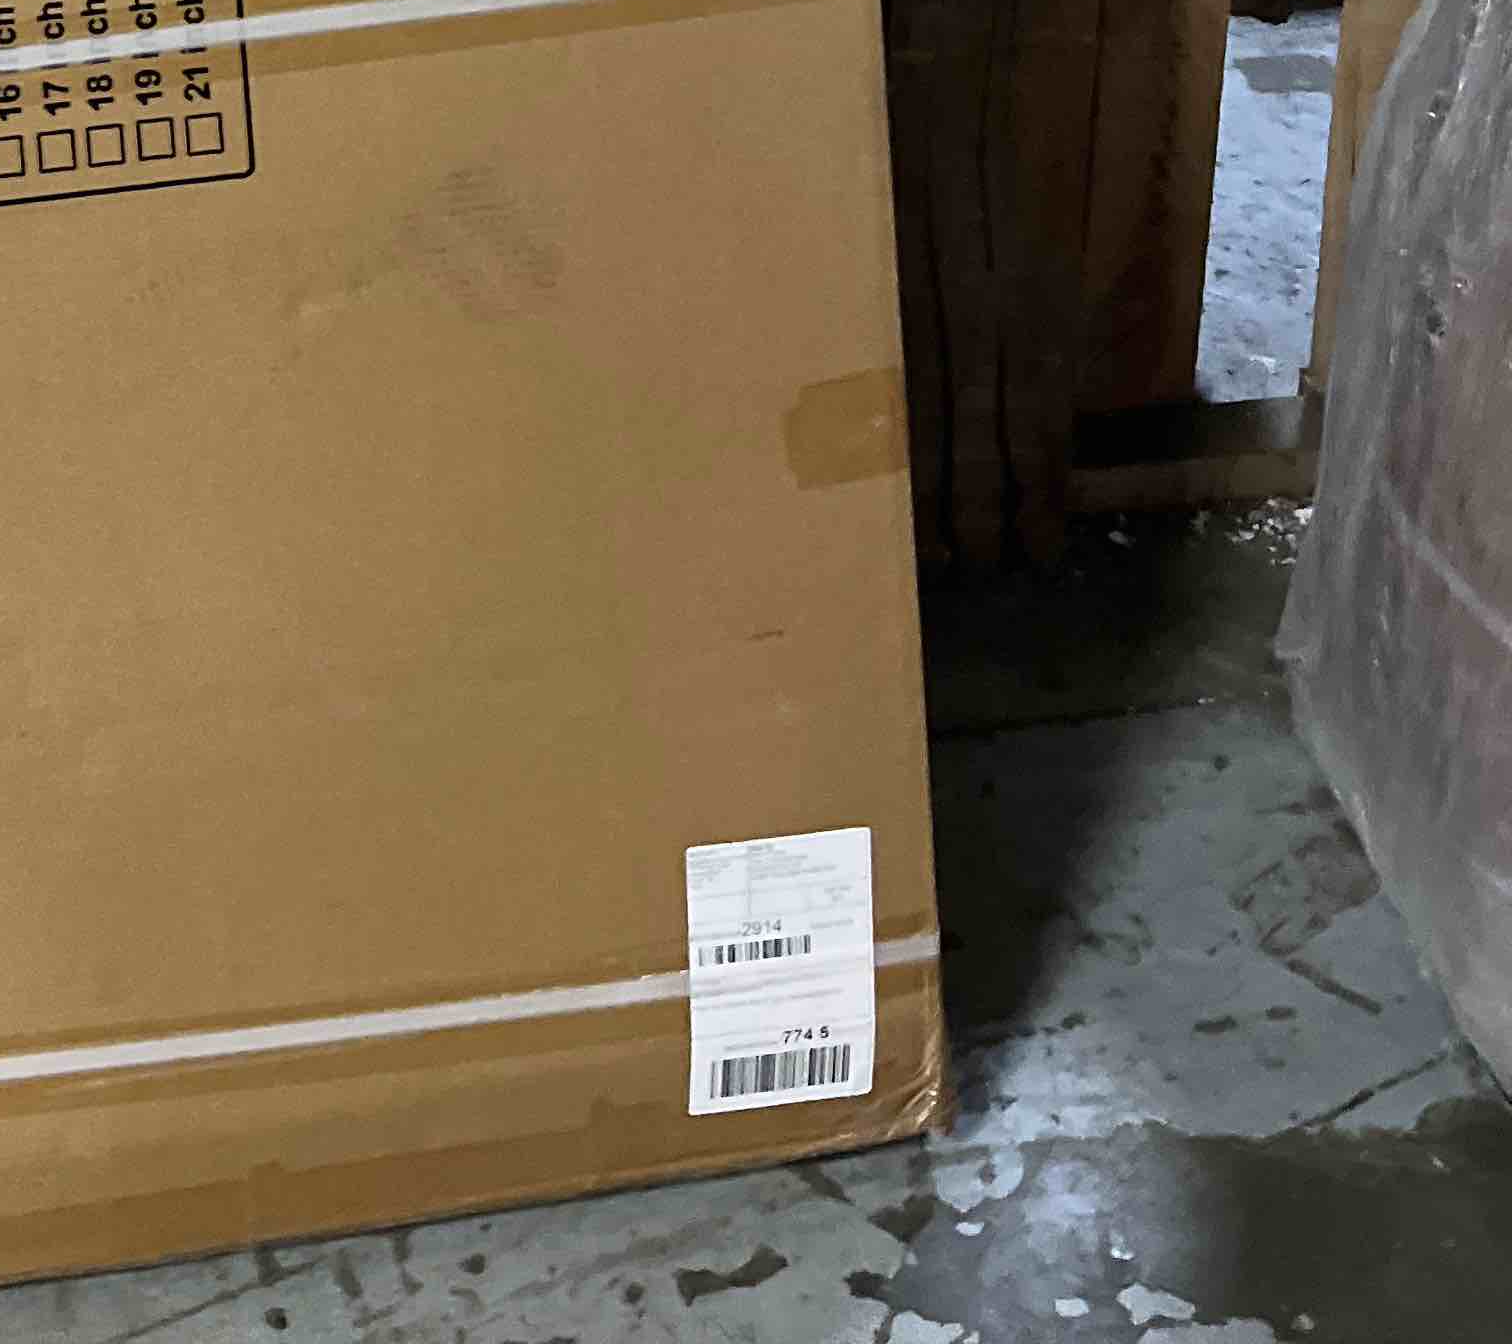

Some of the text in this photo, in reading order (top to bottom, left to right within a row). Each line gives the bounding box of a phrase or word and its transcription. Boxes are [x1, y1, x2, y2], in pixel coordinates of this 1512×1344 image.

[42, 81, 71, 116] 17
[86, 75, 114, 111] 18
[134, 69, 163, 105] 19
[182, 67, 211, 102] 21
